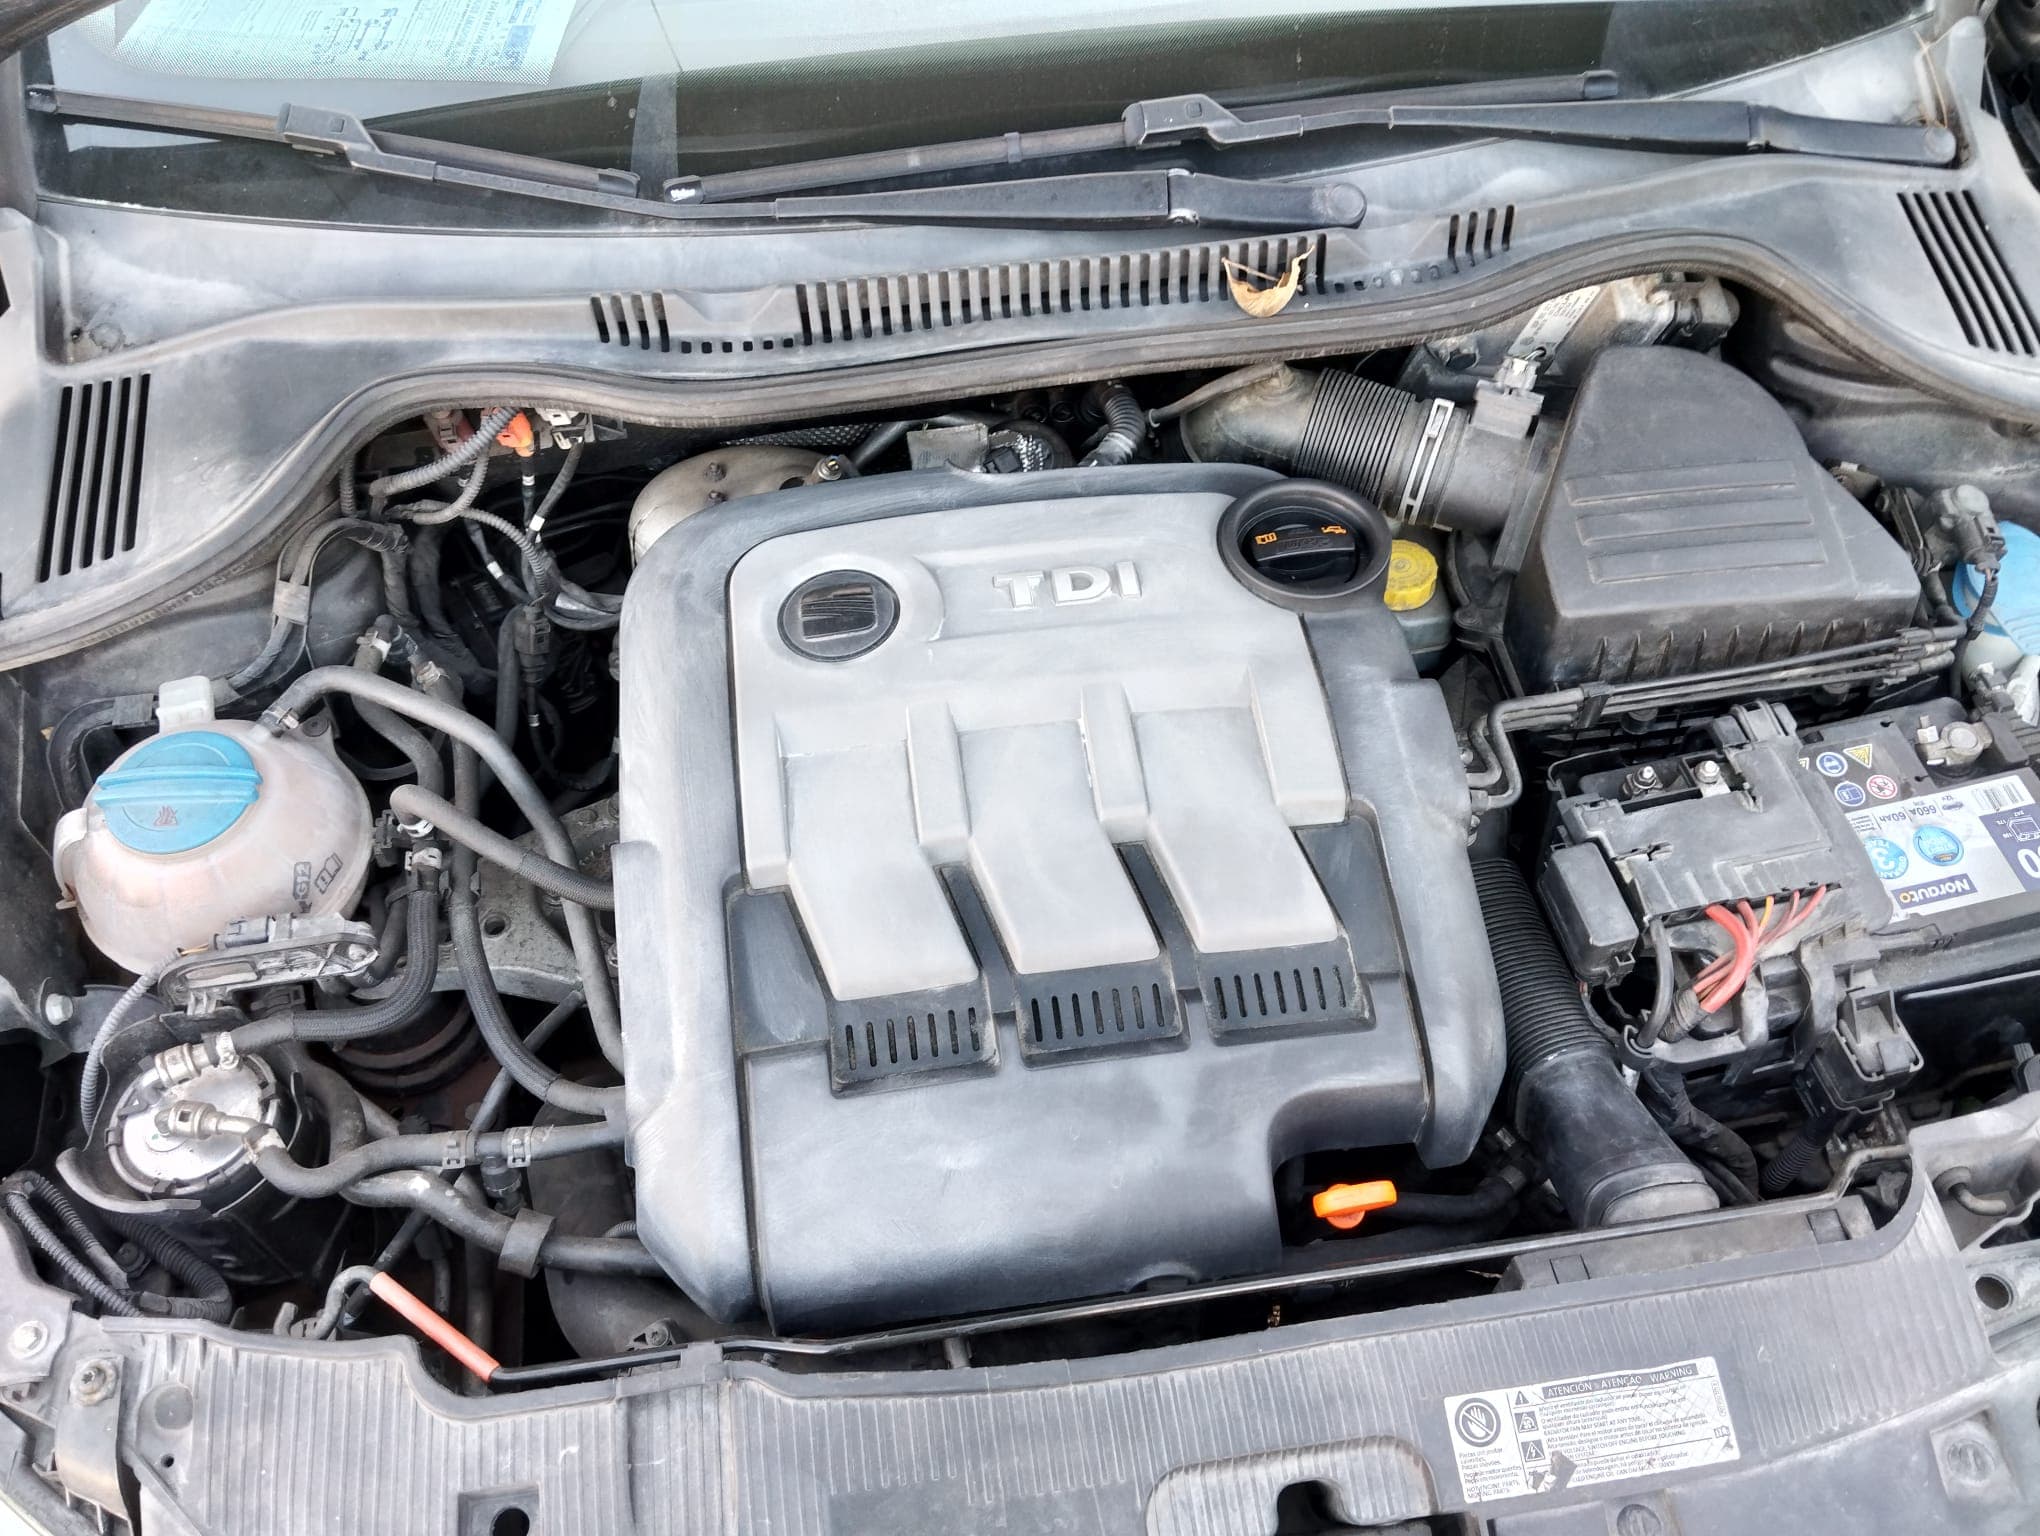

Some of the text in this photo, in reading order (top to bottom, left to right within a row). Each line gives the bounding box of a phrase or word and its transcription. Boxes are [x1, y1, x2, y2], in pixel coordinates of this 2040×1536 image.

[993, 561, 1141, 609] TDI
[1909, 804, 1937, 817] 660A
[2017, 847, 2040, 879] 0
[1899, 878, 1970, 905] Norauto
[1649, 1366, 1693, 1382] WARNING
